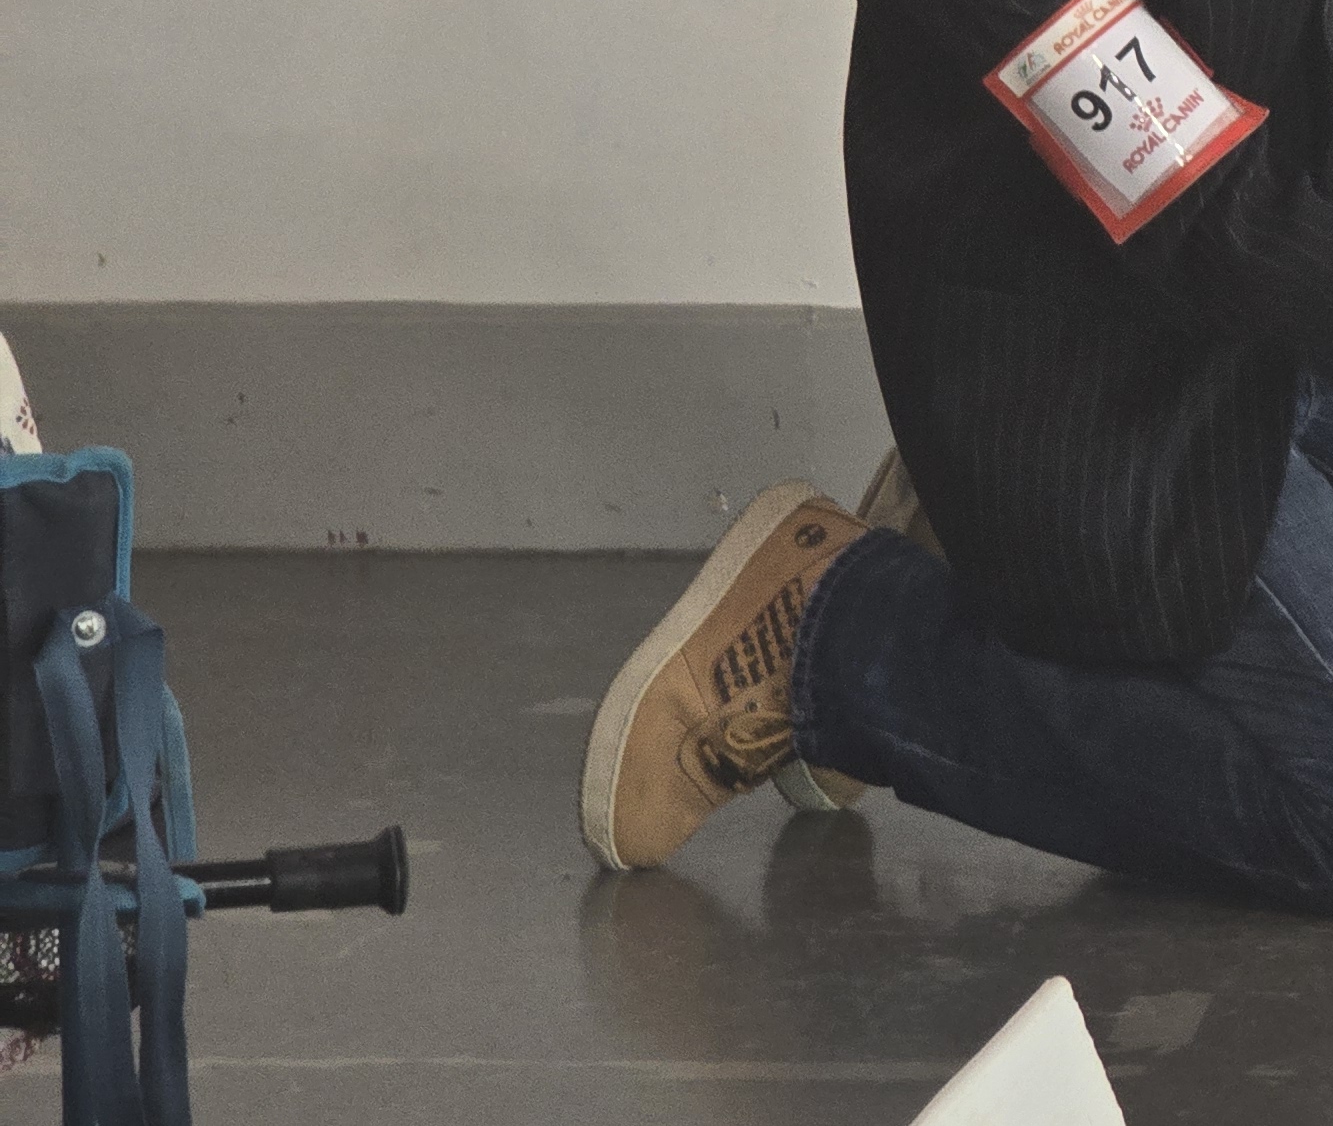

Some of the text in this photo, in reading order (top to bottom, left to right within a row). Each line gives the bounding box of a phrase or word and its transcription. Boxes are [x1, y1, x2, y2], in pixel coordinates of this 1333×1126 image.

[1053, 16, 1095, 56] ROYAL
[1070, 35, 1157, 132] 917
[1122, 88, 1205, 175] ROYAL CANIN
